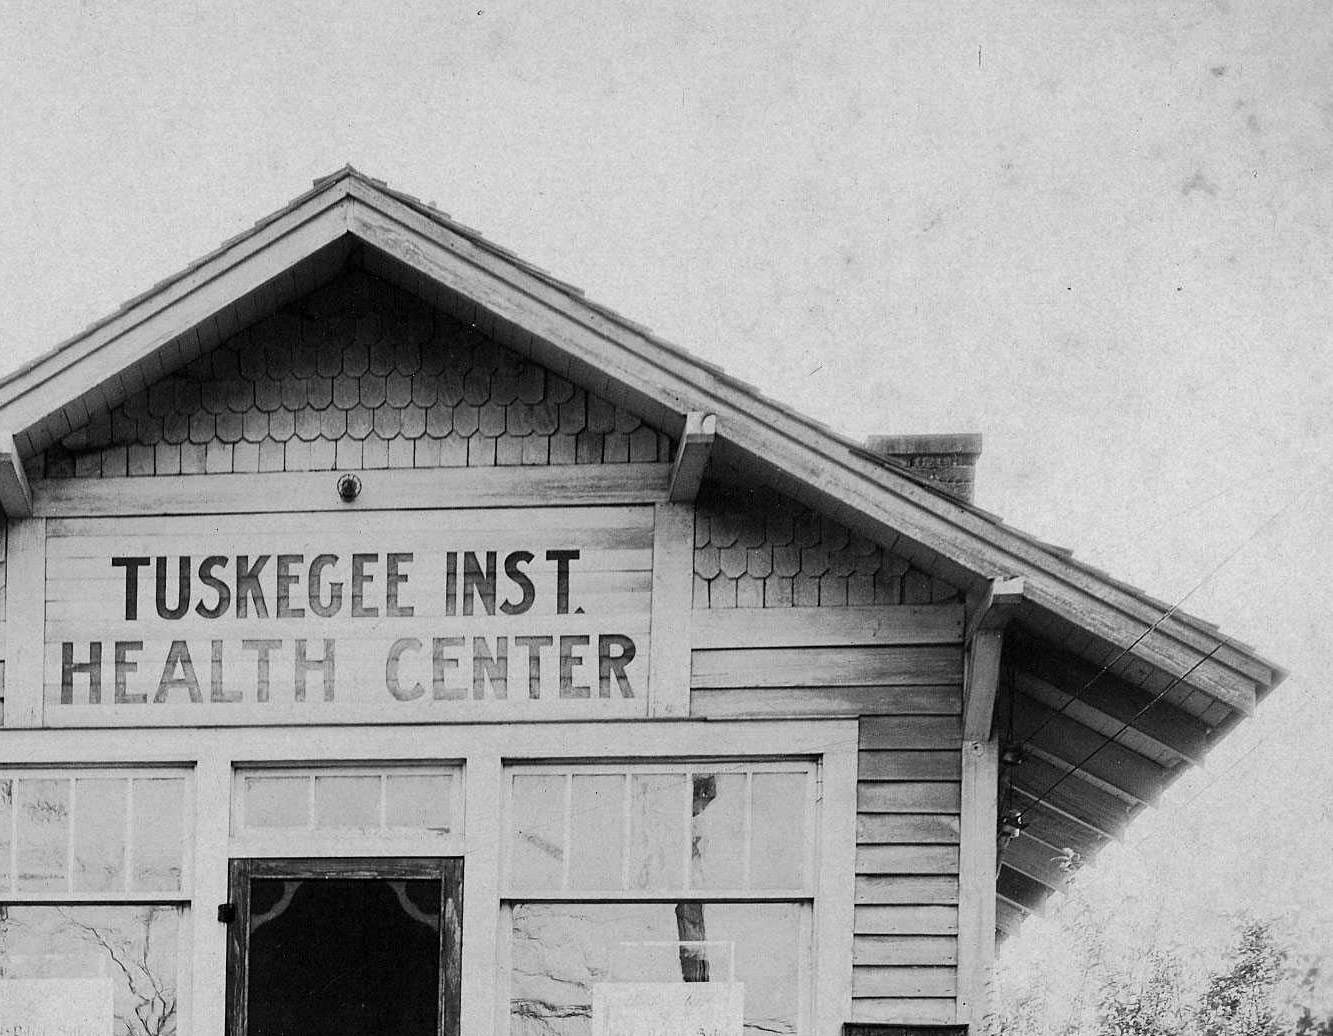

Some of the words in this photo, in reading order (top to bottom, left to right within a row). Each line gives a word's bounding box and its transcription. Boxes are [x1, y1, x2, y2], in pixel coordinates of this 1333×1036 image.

[111, 552, 416, 621] TUSKEGEE
[445, 549, 586, 617] INST.
[60, 638, 337, 705] HEALTH
[384, 633, 638, 702] CENTER
